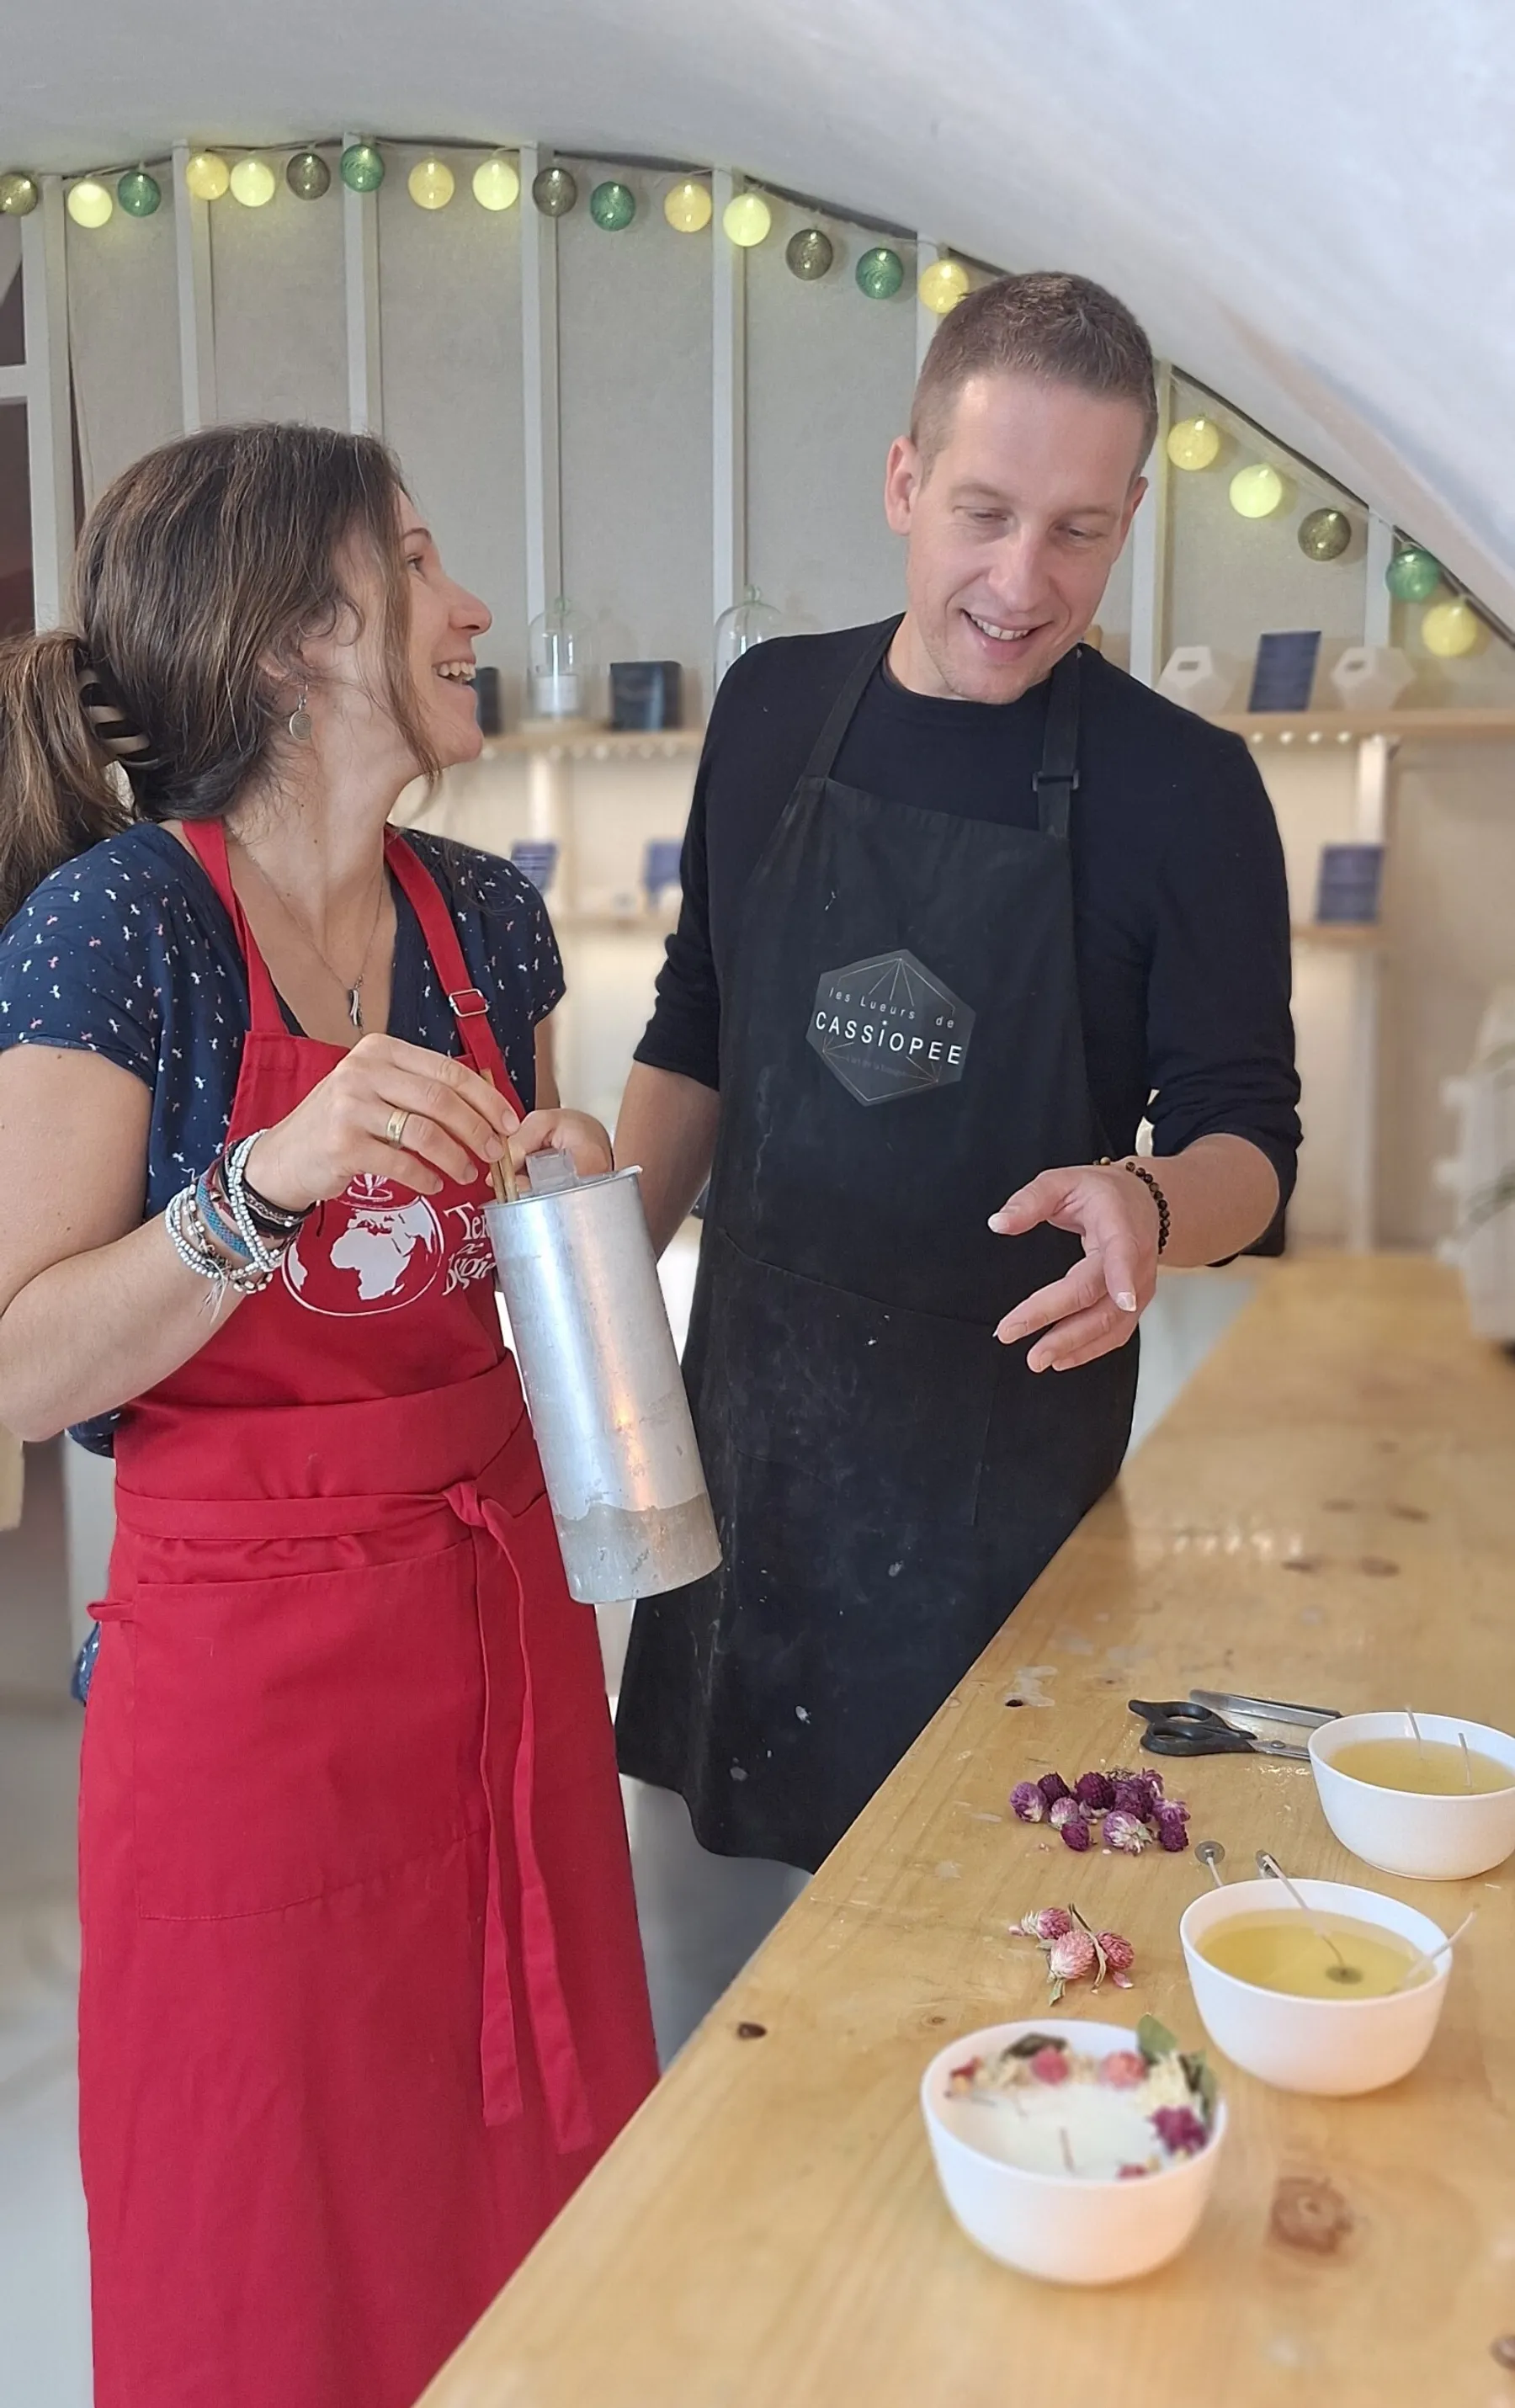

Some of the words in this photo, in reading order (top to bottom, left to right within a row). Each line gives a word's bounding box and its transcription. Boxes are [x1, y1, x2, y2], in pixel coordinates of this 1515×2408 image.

[829, 986, 851, 1003] les
[860, 996, 916, 1020] Lueurs
[935, 1015, 954, 1029] de
